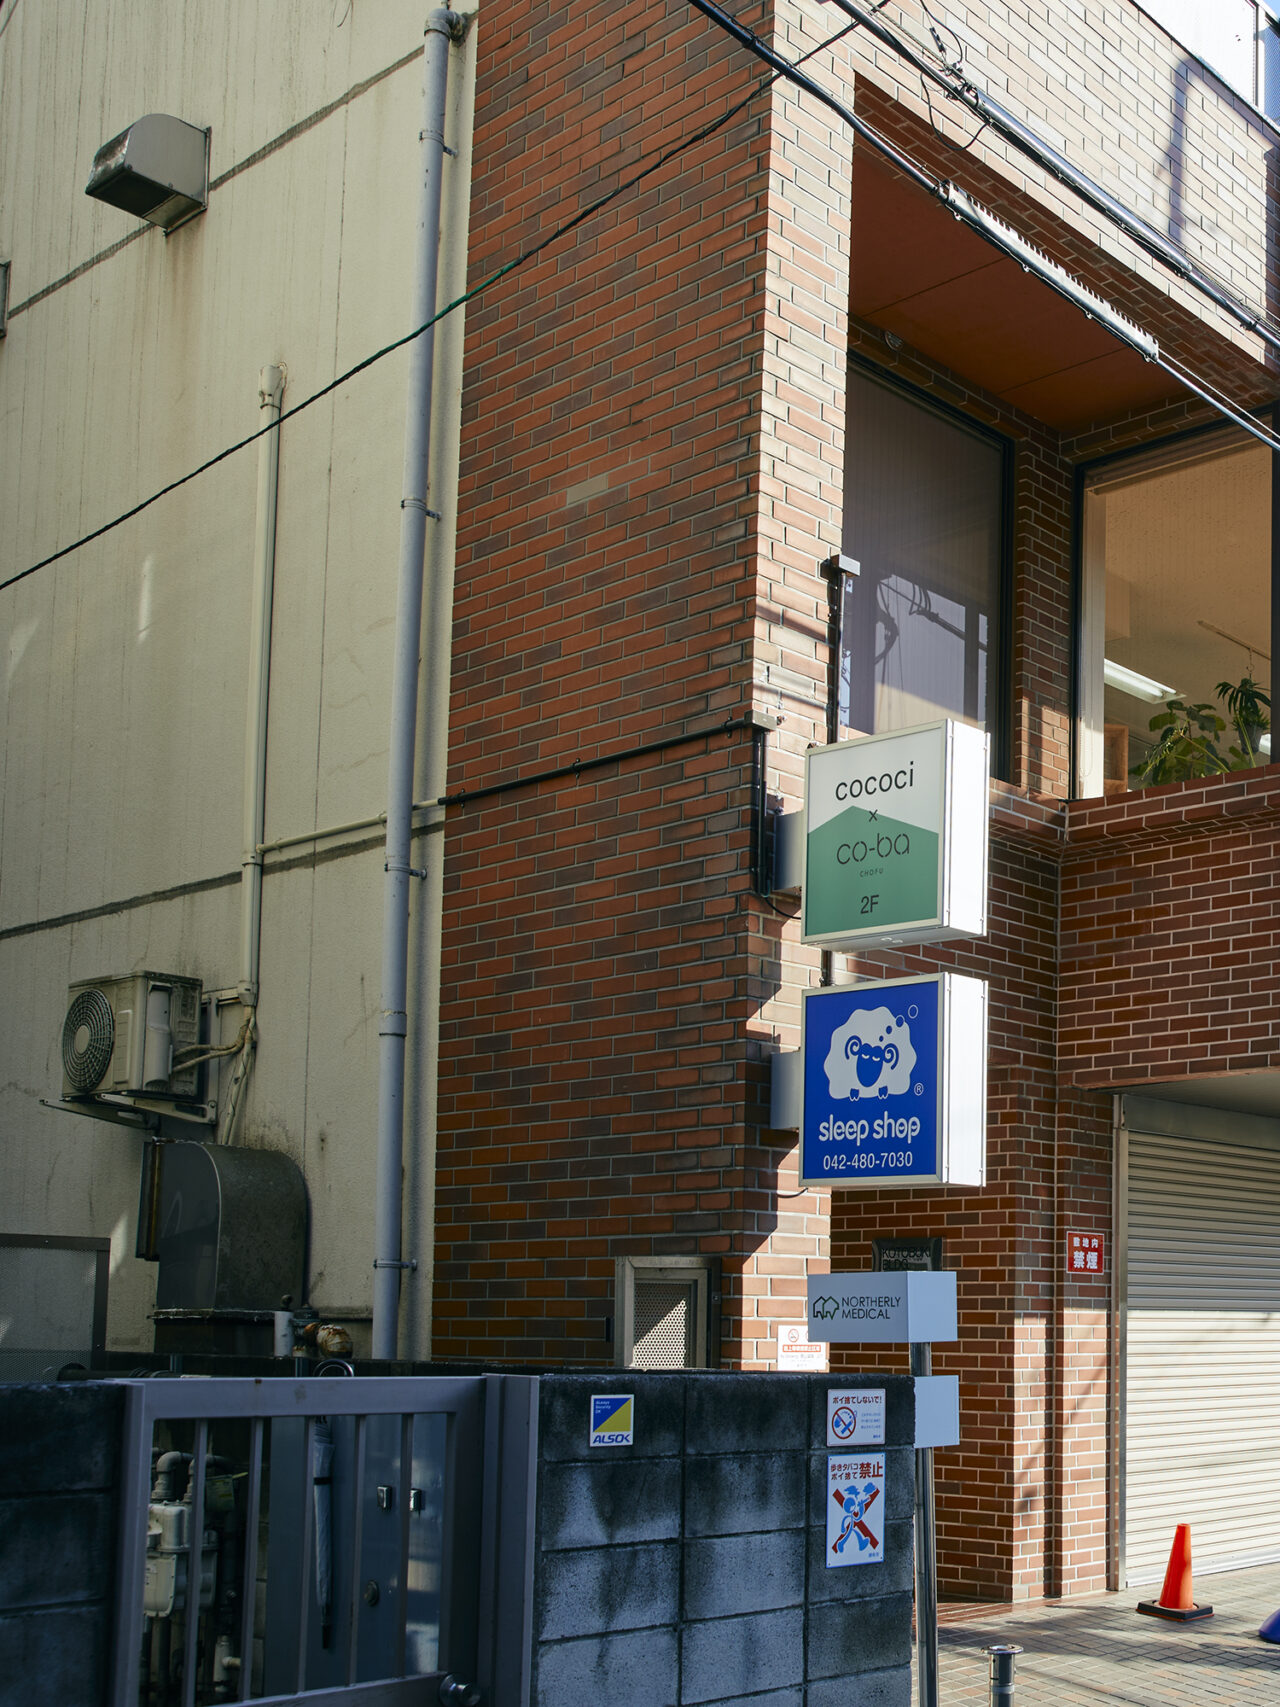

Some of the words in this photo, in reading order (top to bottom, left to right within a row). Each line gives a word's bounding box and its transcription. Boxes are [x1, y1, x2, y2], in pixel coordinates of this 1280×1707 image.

[835, 760, 914, 801] cococi
[836, 832, 910, 865] co-ba
[859, 868, 884, 878] CHOFU
[860, 894, 880, 915] 2F
[818, 1113, 869, 1146] sleep
[872, 1110, 921, 1144] shop
[823, 1151, 913, 1171] 042-480-7030
[882, 1247, 931, 1258] KOTOBUKI
[1073, 1250, 1099, 1269] 禁煙
[841, 1296, 901, 1308] NORTHERLY
[841, 1308, 891, 1320] MEDICAL
[593, 1433, 631, 1444] ALSOK
[858, 1461, 884, 1479] 禁止
